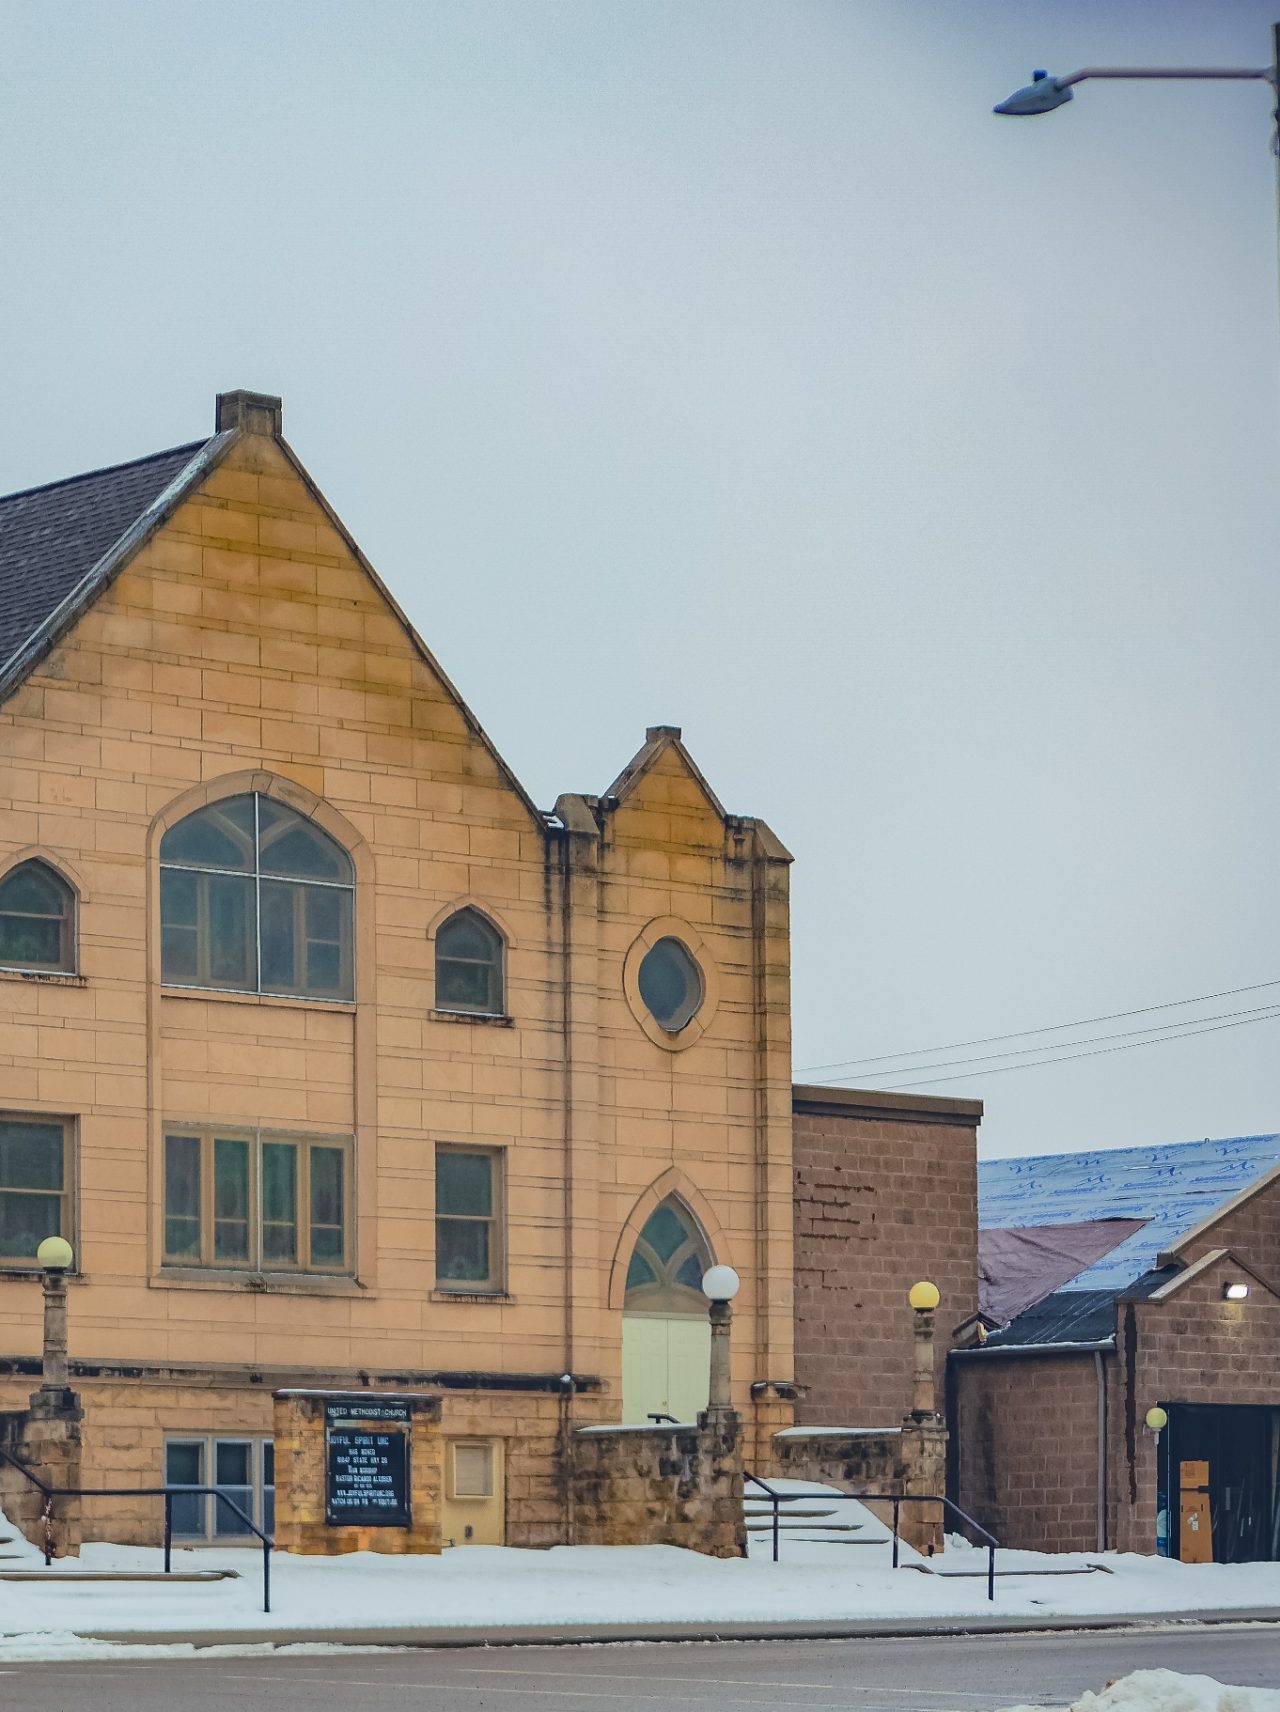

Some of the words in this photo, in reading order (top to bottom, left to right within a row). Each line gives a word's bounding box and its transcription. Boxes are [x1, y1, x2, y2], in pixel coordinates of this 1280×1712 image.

[327, 1407, 347, 1415] UNITED
[350, 1407, 381, 1416] METHODIST
[384, 1408, 407, 1417] CHURCH
[329, 1436, 351, 1445] JOYFUL
[355, 1436, 374, 1445] SPIRIT
